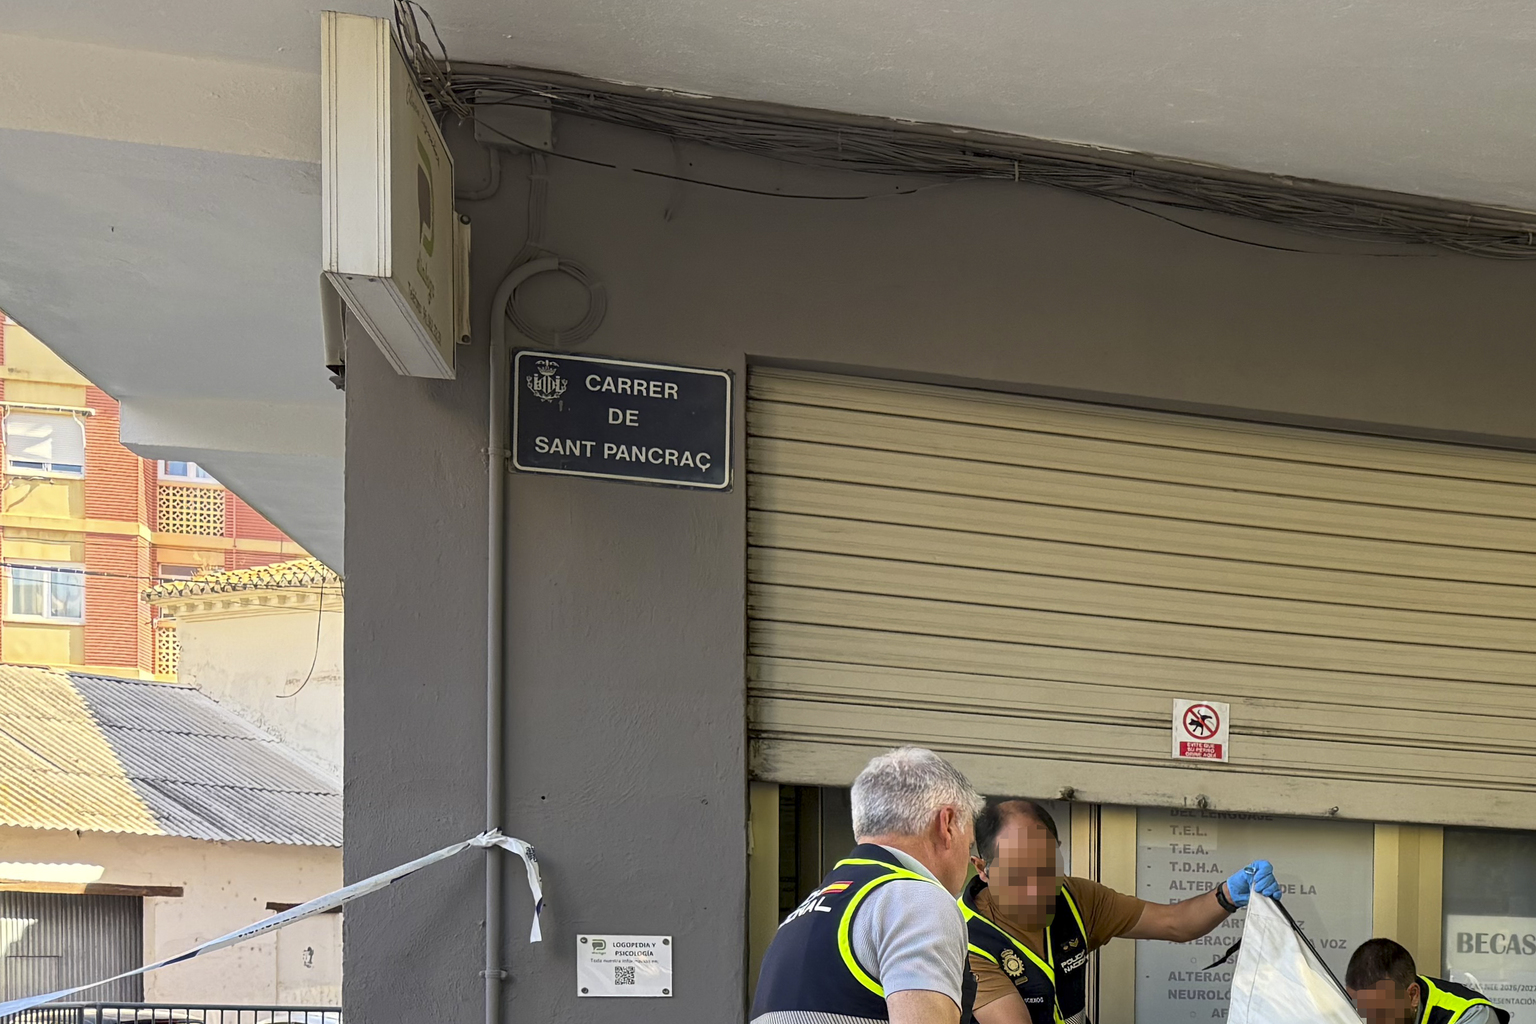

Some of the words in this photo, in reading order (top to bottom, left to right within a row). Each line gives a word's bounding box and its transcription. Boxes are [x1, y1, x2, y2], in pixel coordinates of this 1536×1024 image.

[585, 374, 679, 400] CARRER
[608, 407, 640, 427] DE
[535, 436, 596, 458] SANT
[603, 442, 712, 473] PANCRAÇ
[1170, 825, 1208, 837] T.E.L.
[1170, 844, 1209, 855] T.E.A.
[1170, 862, 1223, 874] T.D.H.A.
[1300, 884, 1317, 896] LA
[1320, 938, 1347, 950] VOZ
[1457, 932, 1536, 956] BECAS
